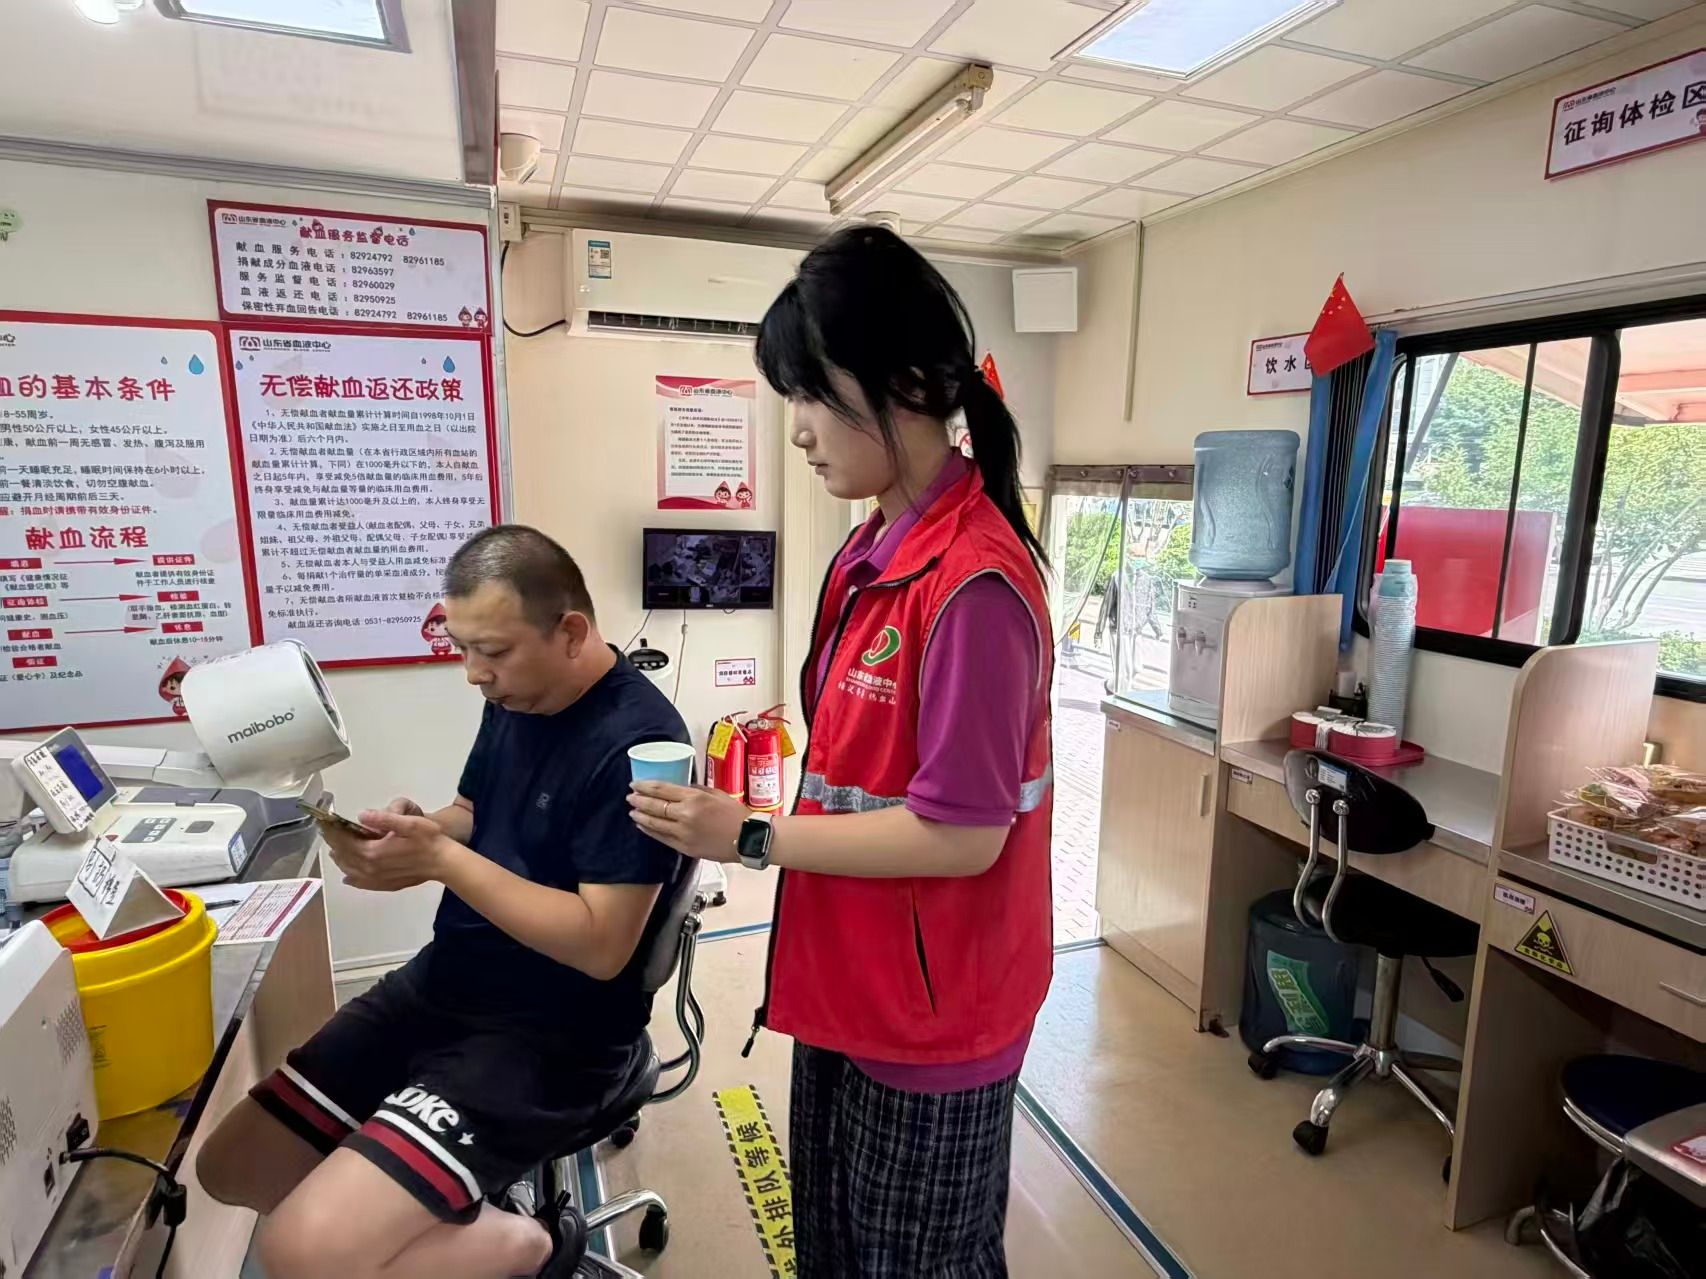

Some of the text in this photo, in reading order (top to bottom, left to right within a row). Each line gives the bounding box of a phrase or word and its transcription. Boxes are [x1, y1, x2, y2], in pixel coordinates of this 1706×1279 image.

[1563, 81, 1706, 146] 征询体检区
[299, 224, 409, 247] 献血服务监督电话
[350, 251, 393, 263] 82924792
[403, 255, 445, 267] 82961185
[351, 266, 395, 277] 82963597
[352, 279, 396, 290] 82960029
[353, 294, 396, 305] 82950925
[354, 308, 397, 320] 82924792
[407, 312, 448, 322] 82961185
[262, 339, 331, 349] 山东省血液中心
[1265, 355, 1312, 374] 饮水
[260, 374, 464, 402] 无偿献血返还政策
[24, 525, 149, 550] 献血流程
[364, 616, 421, 625] 0531-82950925
[227, 711, 295, 744] maibobo
